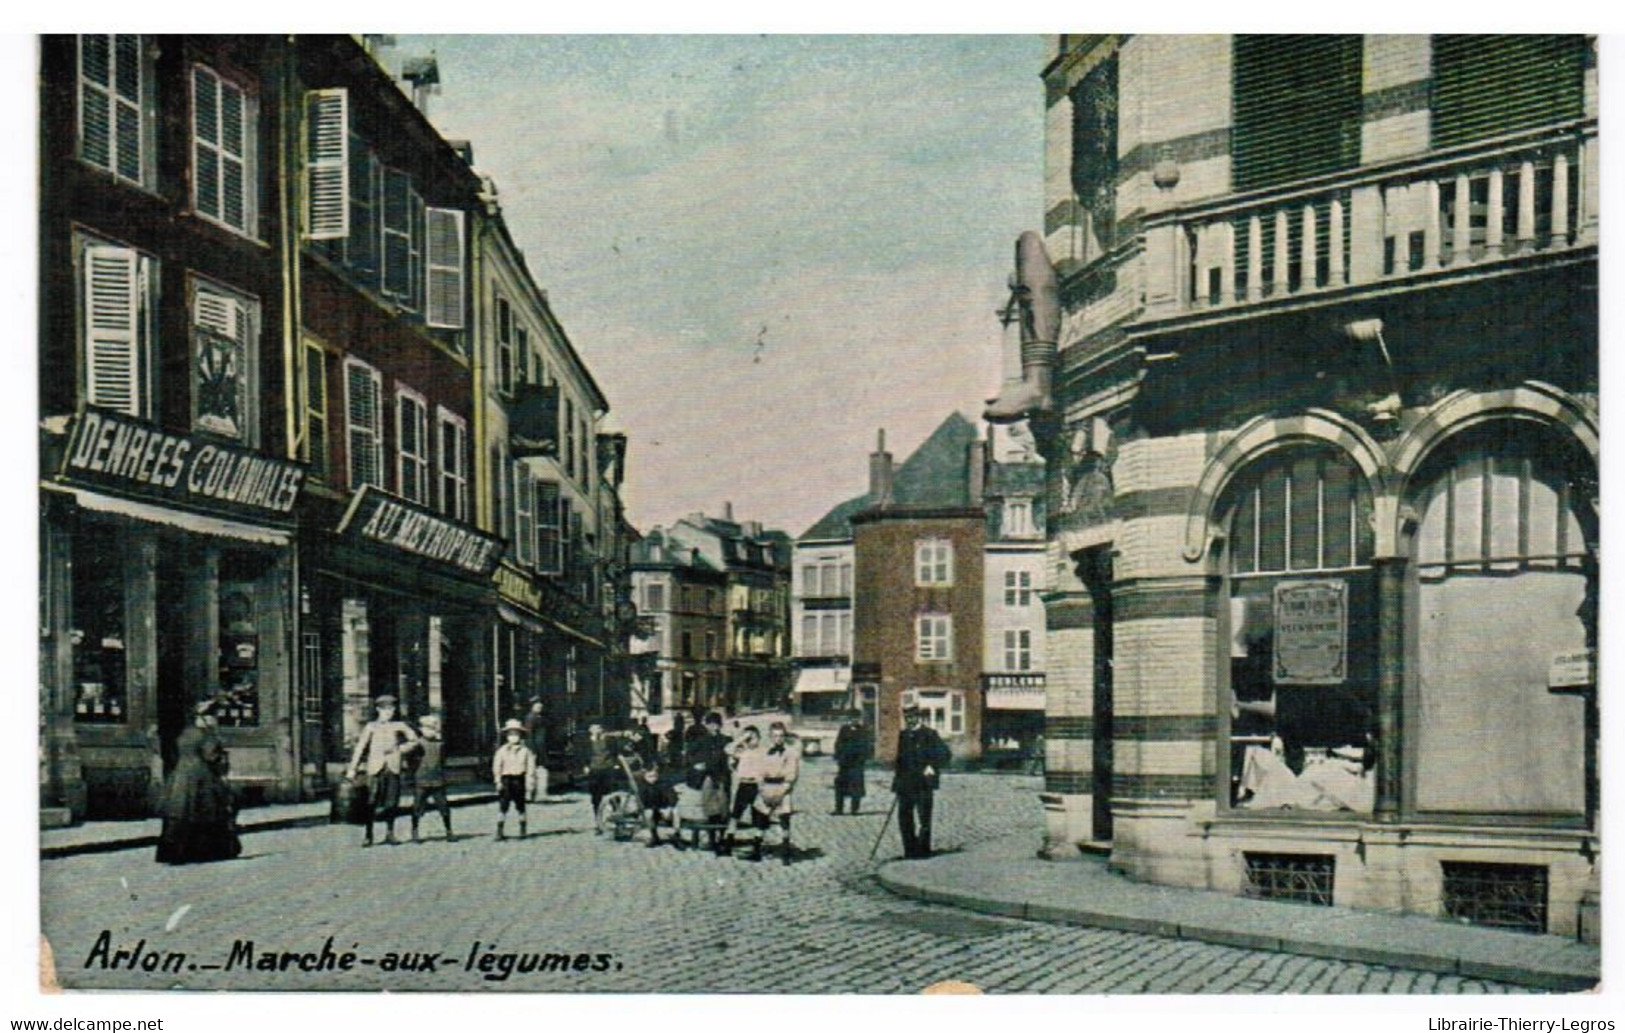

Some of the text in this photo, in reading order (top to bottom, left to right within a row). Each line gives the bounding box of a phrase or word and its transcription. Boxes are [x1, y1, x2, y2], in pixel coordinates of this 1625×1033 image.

[71, 411, 303, 512] DENREES COLONIALES
[361, 500, 494, 573] AU METROPOLE
